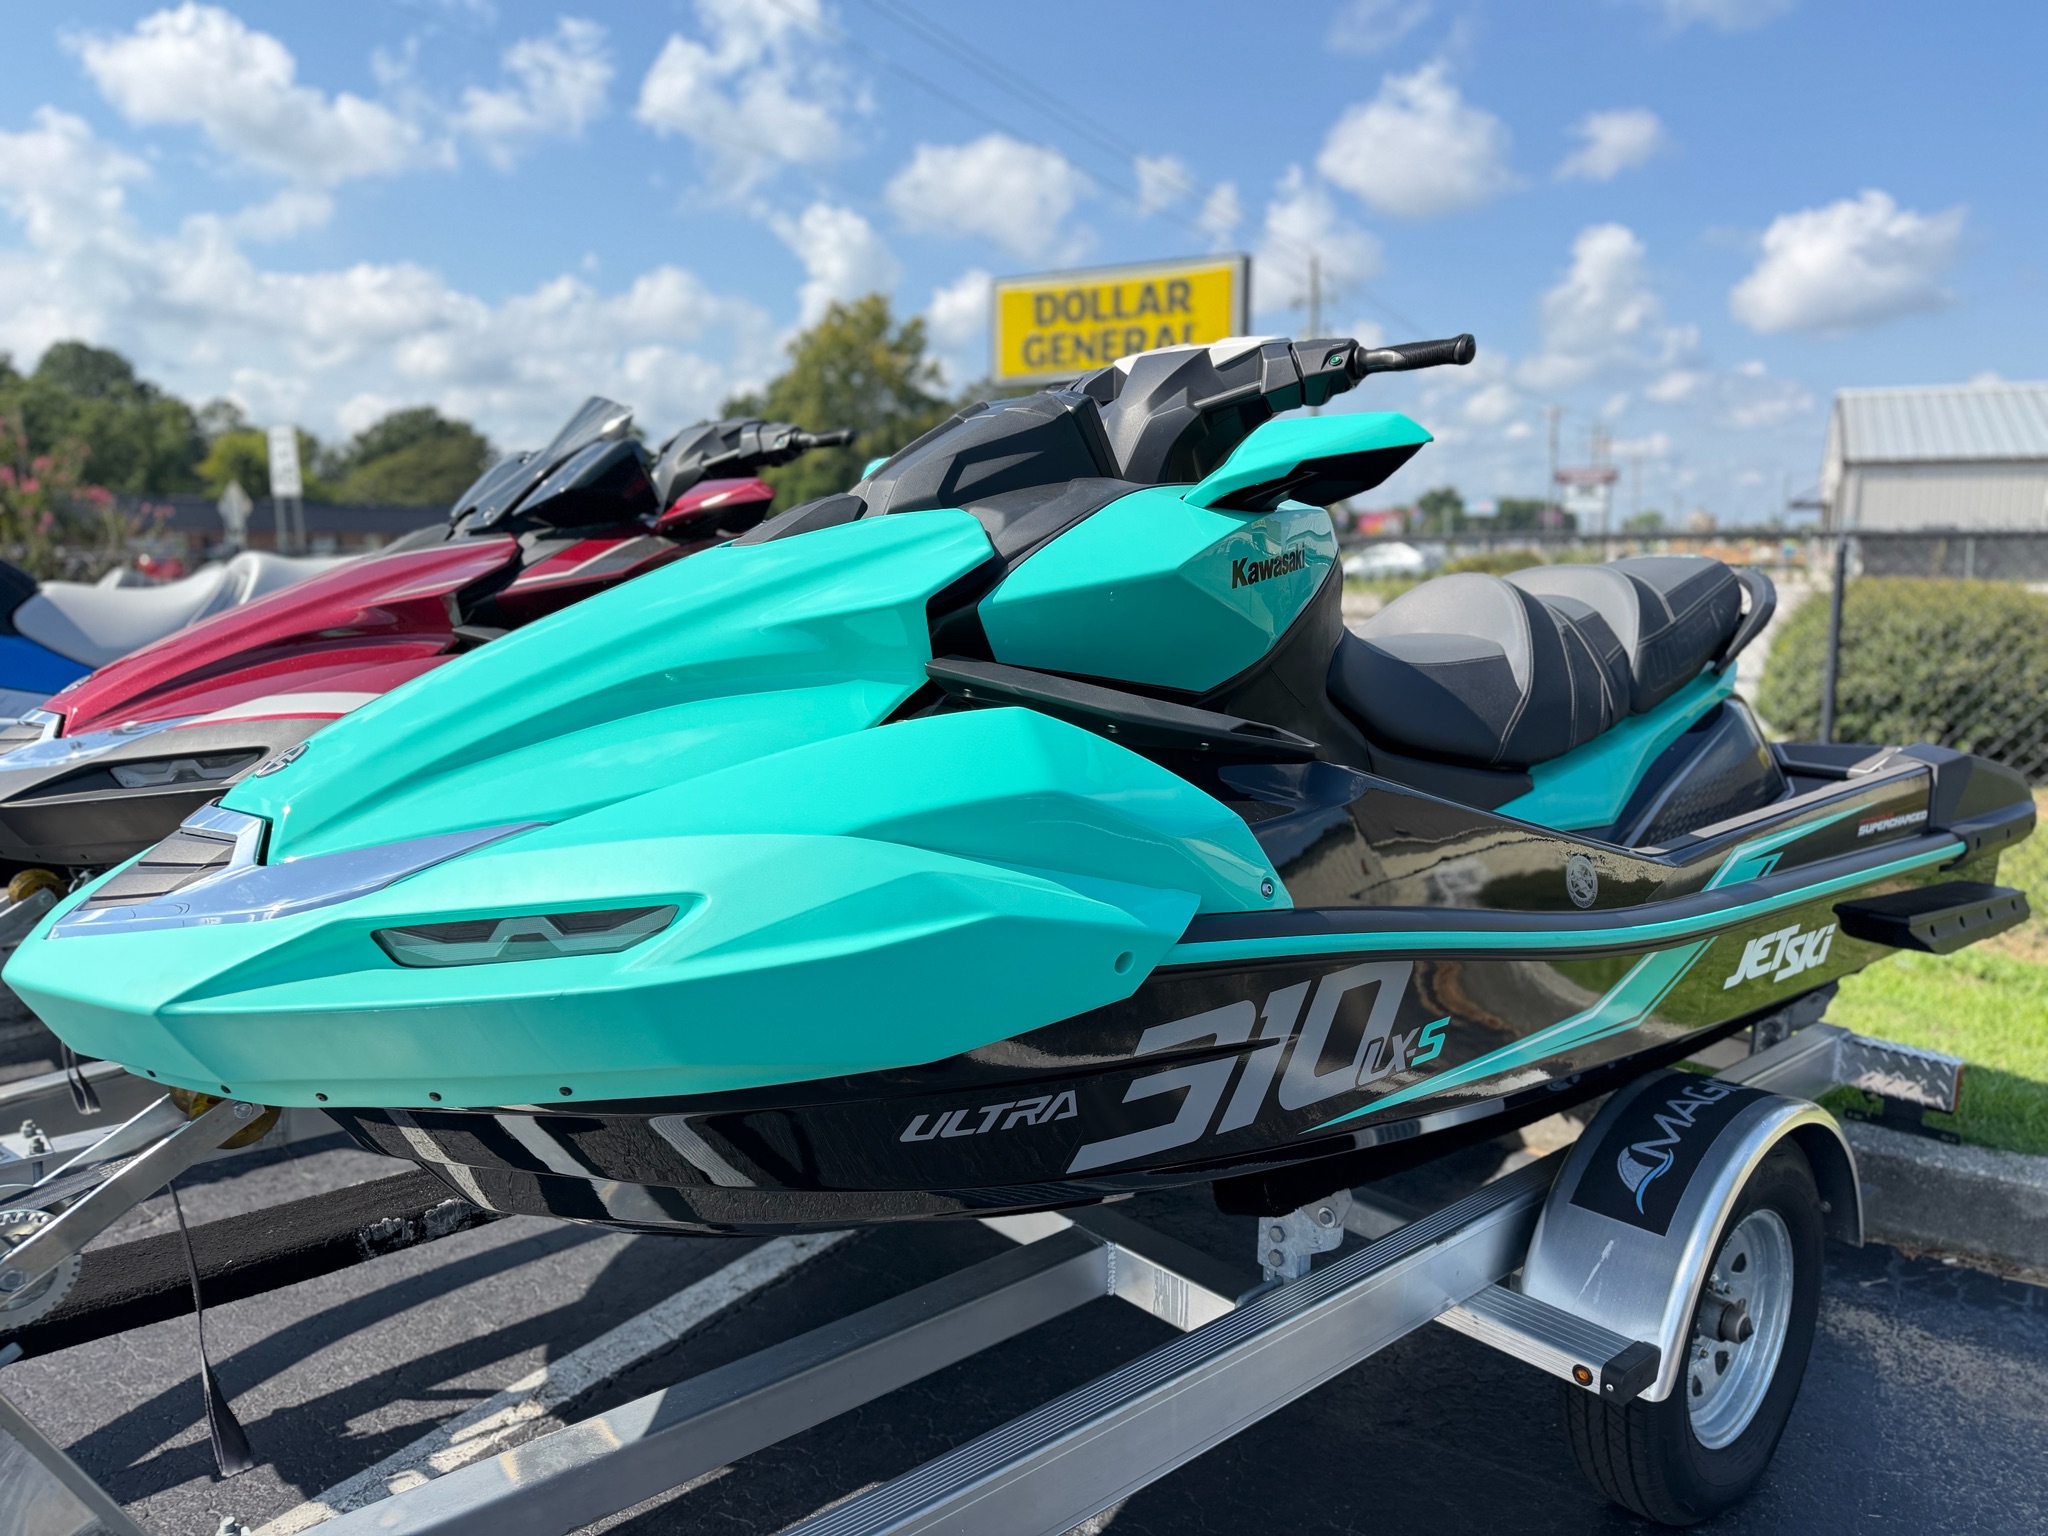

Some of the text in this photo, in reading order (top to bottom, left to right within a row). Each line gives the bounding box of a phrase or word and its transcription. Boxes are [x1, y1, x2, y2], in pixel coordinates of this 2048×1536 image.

[1033, 280, 1192, 327] DOLLAR
[1231, 541, 1306, 590] Kawasaki
[1857, 809, 1928, 837] SUPERCHARGED
[899, 960, 1451, 1175] ULTRA 310 LX-S
